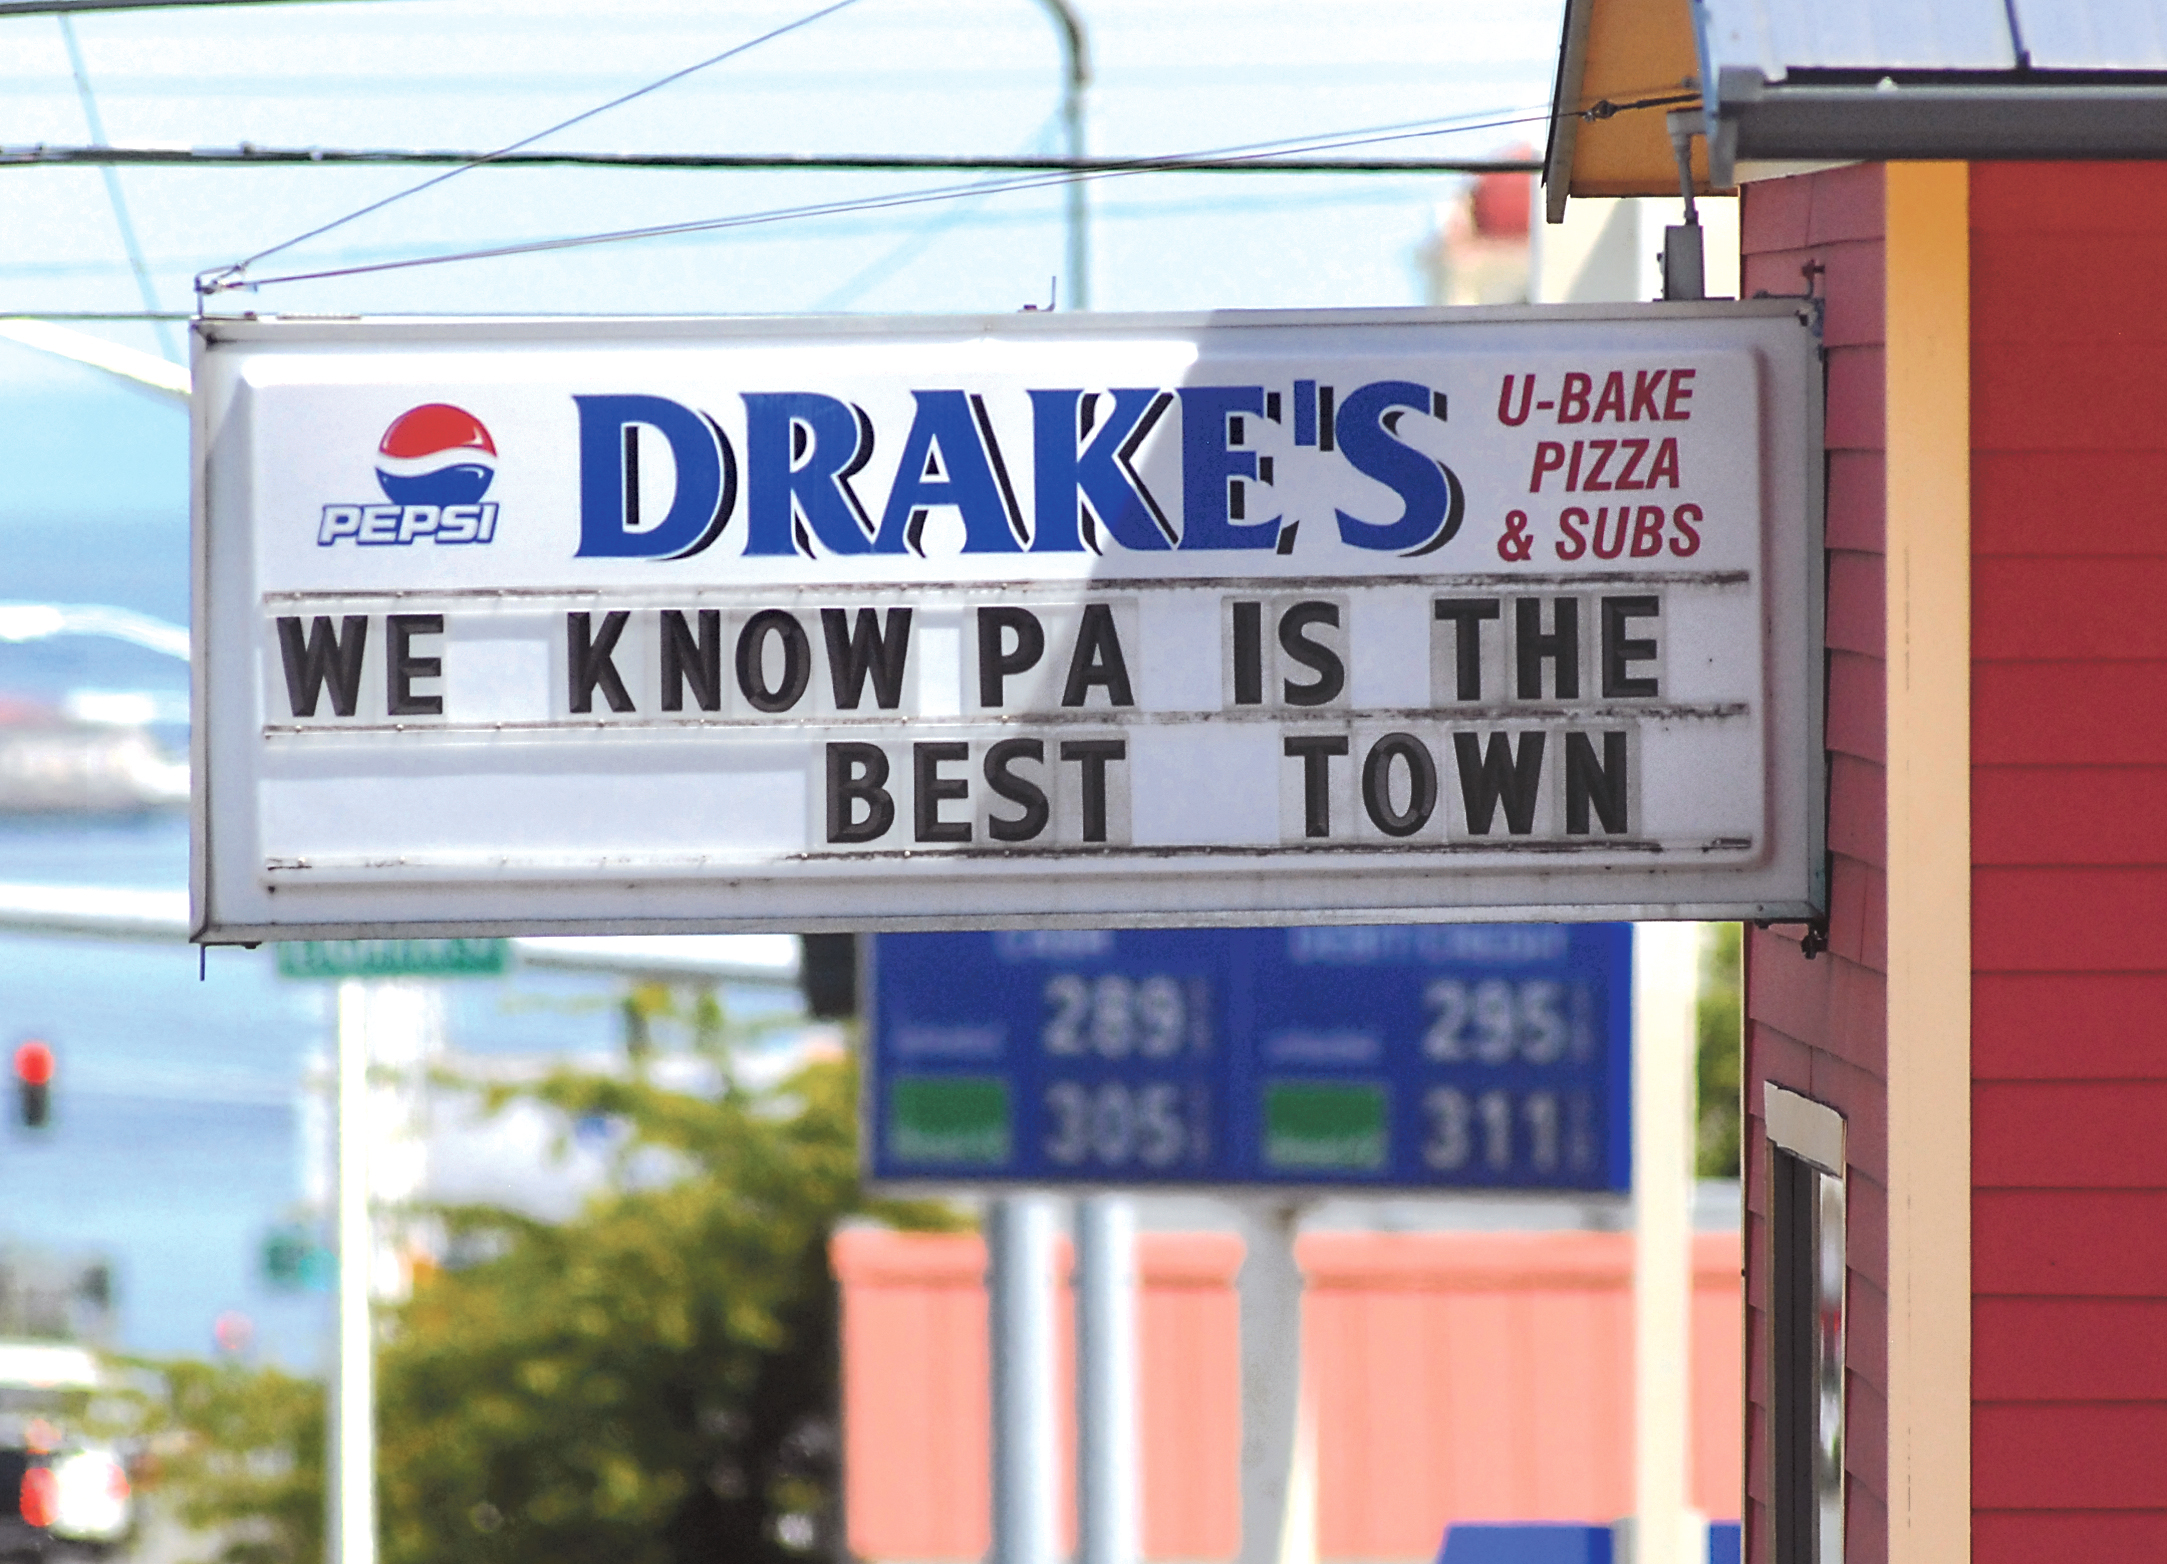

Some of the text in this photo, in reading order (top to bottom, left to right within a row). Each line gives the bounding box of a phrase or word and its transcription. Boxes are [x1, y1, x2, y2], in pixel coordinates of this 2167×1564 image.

[1498, 368, 1696, 426] U-BAKE
[571, 379, 1466, 561] DRAKE'S
[1529, 437, 1680, 493] PIZZA
[317, 502, 500, 546] PEPSI
[1497, 503, 1703, 562] & SUBS
[276, 595, 1660, 717] WE KNOW PA IS THE
[826, 732, 1629, 844] BEST TOWN
